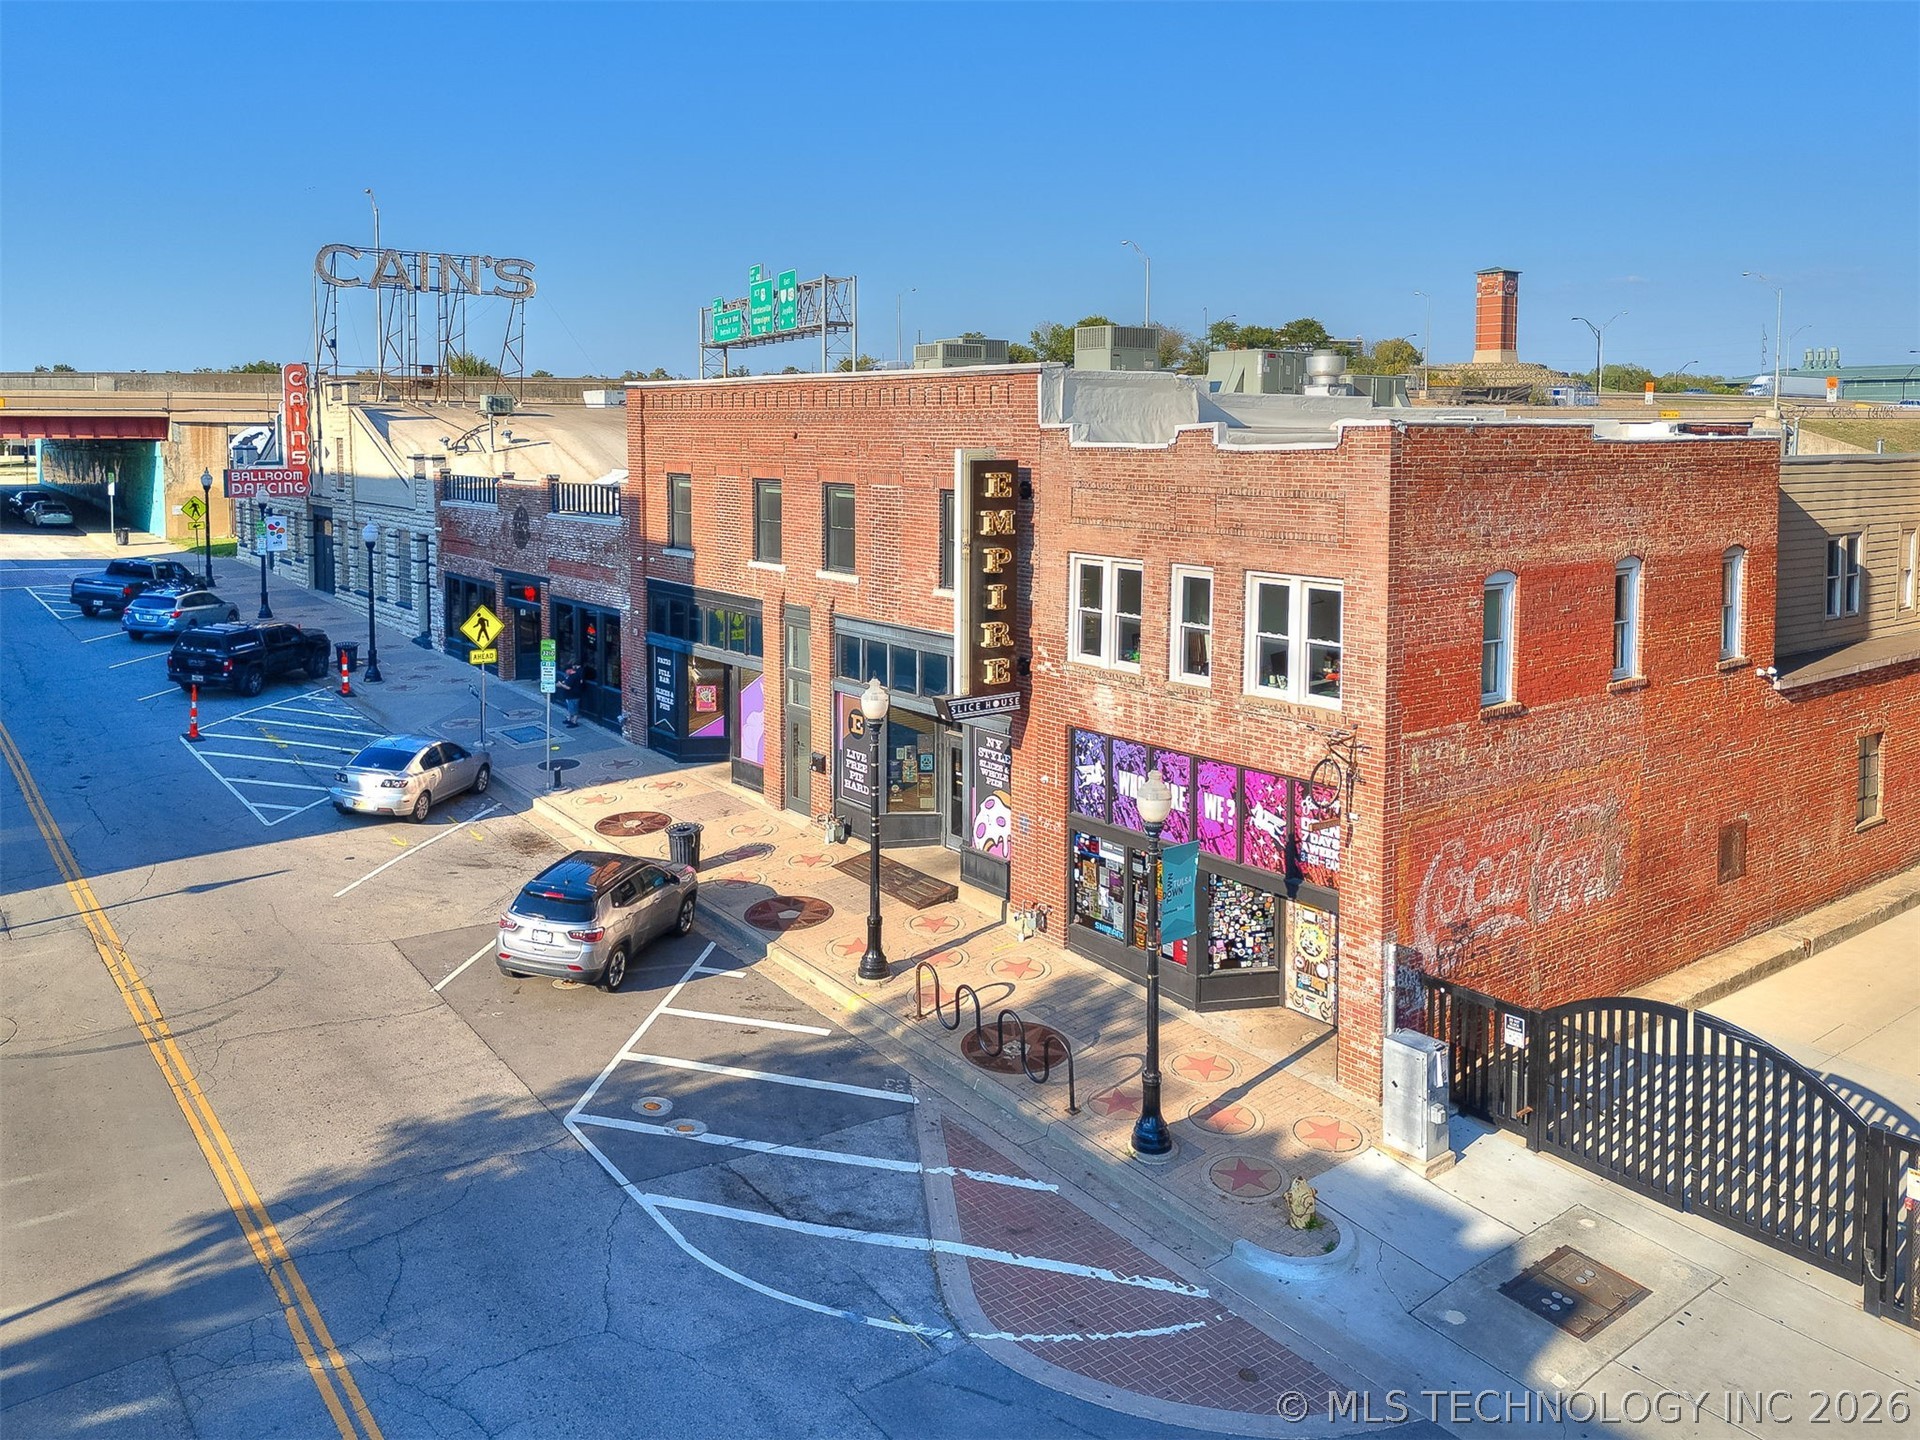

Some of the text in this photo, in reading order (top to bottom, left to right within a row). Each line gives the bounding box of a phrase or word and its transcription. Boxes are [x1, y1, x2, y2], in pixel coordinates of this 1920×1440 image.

[315, 243, 536, 299] CAIN'S
[289, 371, 306, 465] CAINS
[231, 471, 303, 481] BALLROOM
[980, 472, 1016, 685] EMPIRE
[473, 652, 494, 660] AHEAD
[951, 697, 1020, 714] SLICE HOUSE
[986, 737, 1003, 750] NY
[846, 749, 868, 763] LIVE
[978, 747, 1011, 764] STYLE
[846, 759, 868, 773] FREE
[979, 760, 1004, 773] SLICES
[849, 770, 864, 783] PIE
[980, 768, 1009, 783] WHOLE
[986, 777, 1002, 788] PIES
[844, 779, 869, 795] HARD
[1164, 782, 1187, 812] RE
[1301, 830, 1340, 851] 7 DAYS
[1309, 843, 1340, 862] WEEK
[1173, 876, 1193, 889] TULSA
